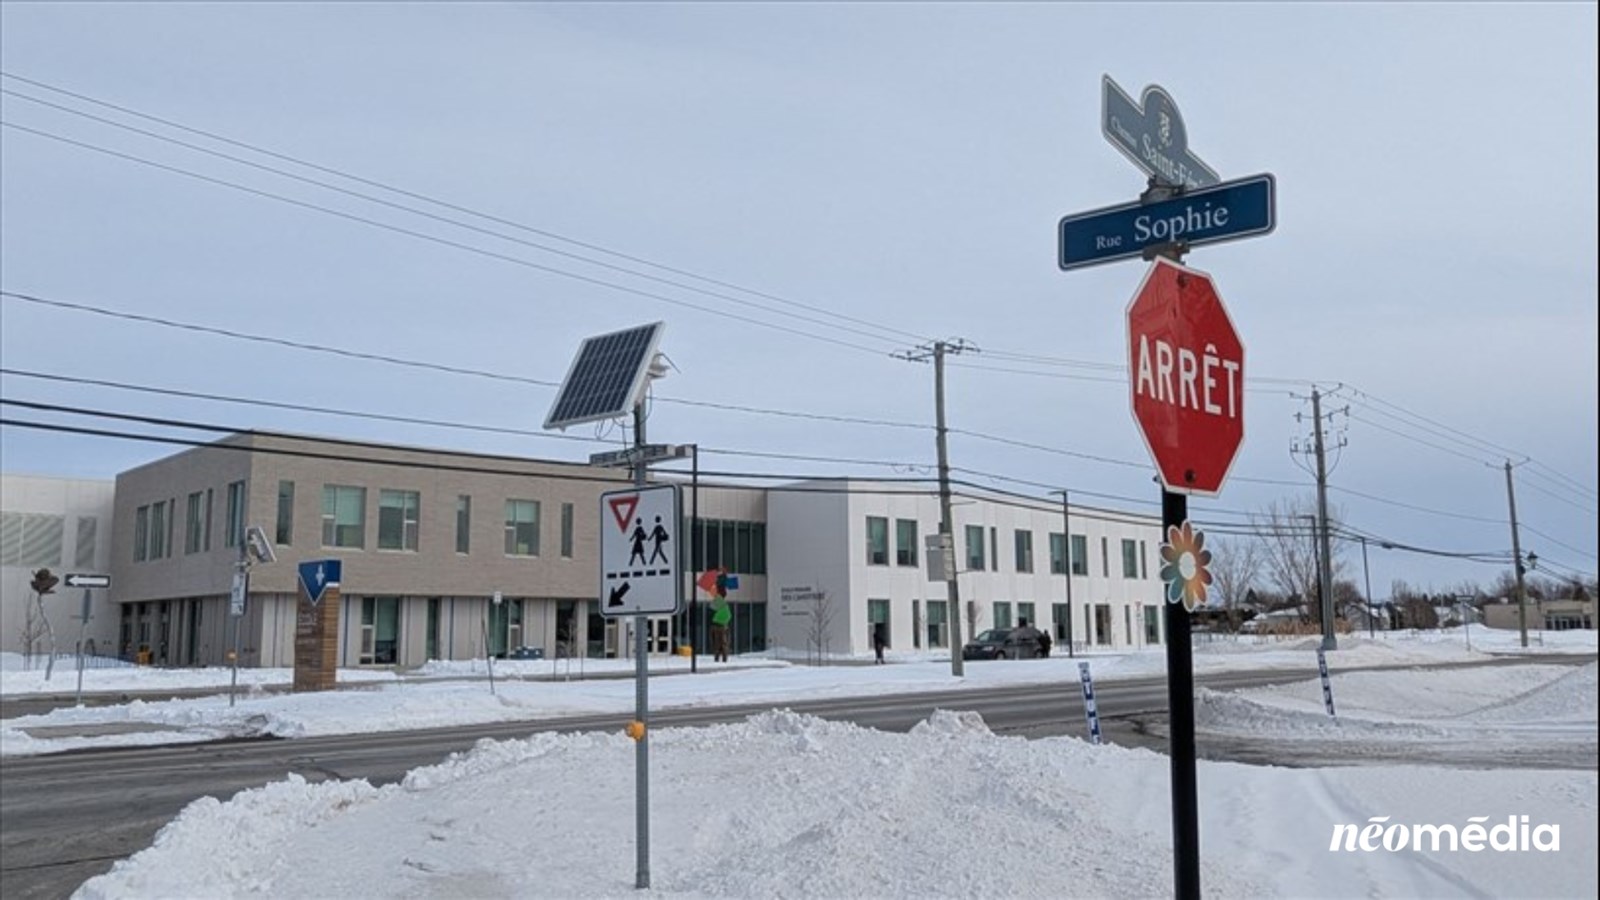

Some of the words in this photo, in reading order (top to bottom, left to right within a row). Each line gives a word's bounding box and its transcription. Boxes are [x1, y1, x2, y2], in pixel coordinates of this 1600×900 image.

[1096, 235, 1122, 249] Rue
[1134, 202, 1229, 242] Sophie
[1137, 333, 1240, 419] ARRÊT
